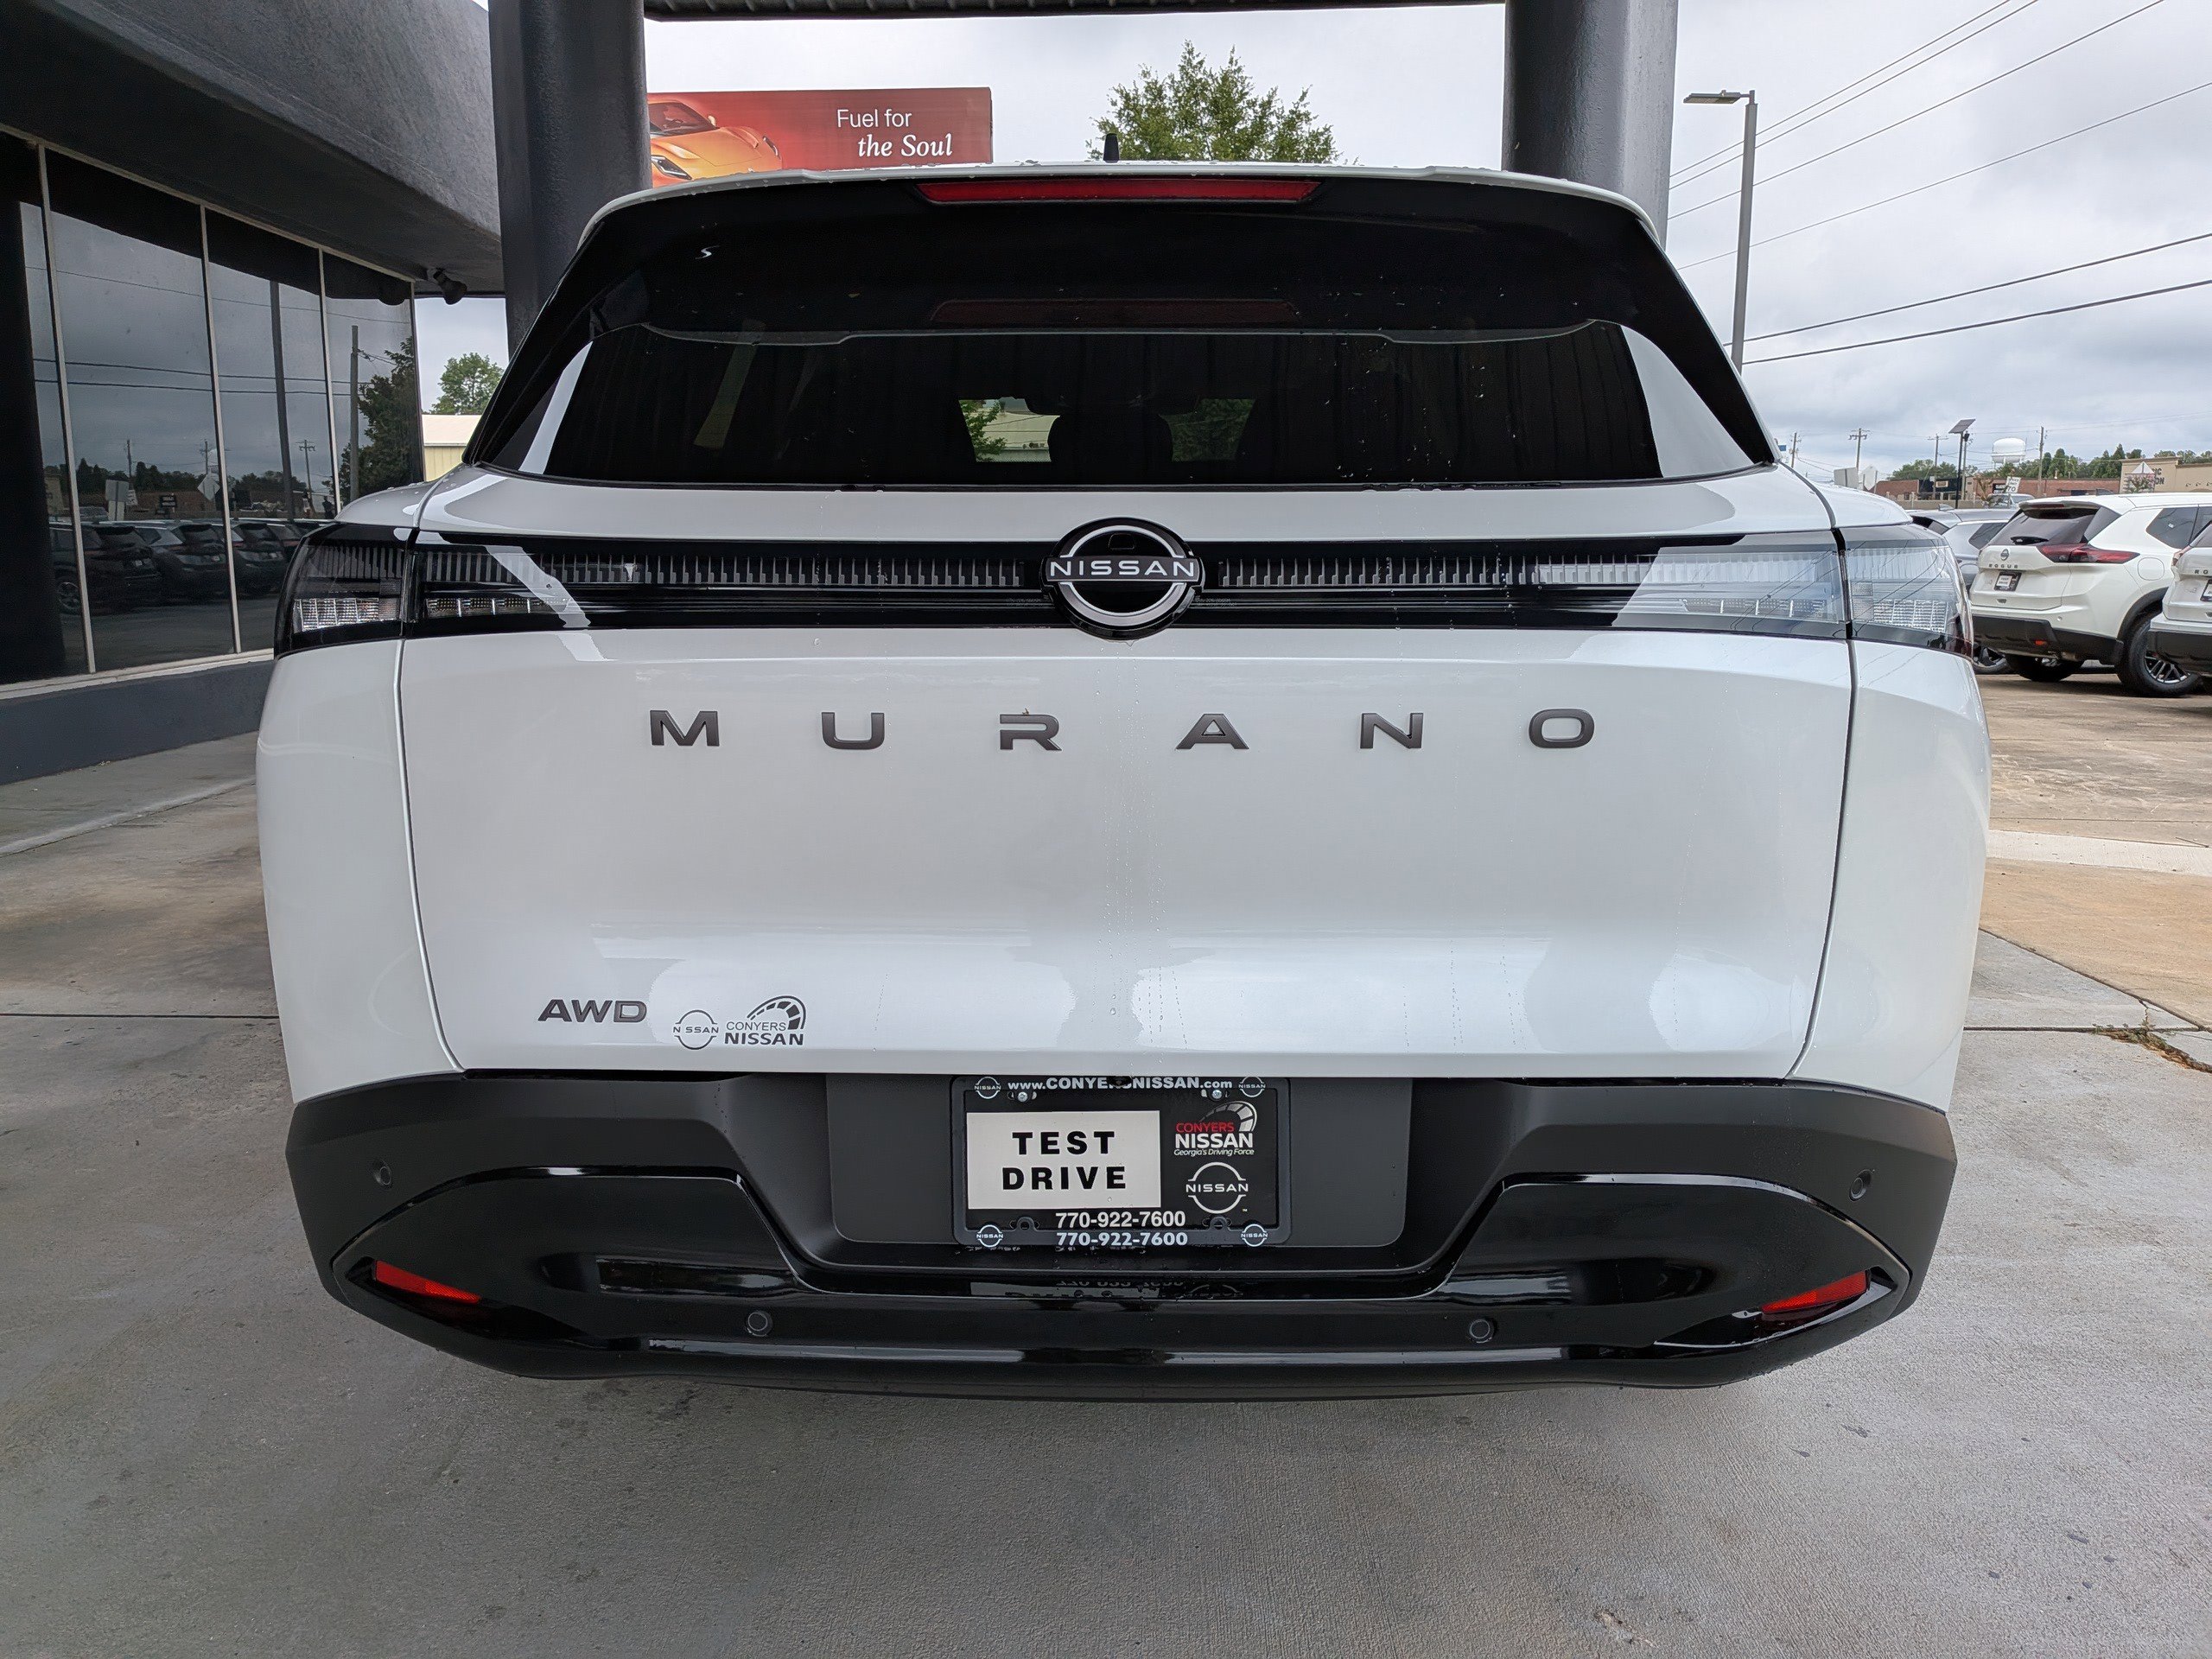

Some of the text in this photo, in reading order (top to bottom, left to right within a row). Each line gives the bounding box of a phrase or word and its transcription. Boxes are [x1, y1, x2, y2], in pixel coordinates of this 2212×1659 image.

[837, 109, 912, 128] Fuel for
[858, 133, 952, 156] the Soul
[1050, 560, 1194, 576] NISSAN
[650, 709, 1596, 751] MURANO
[537, 999, 647, 1023] AWD
[726, 1021, 786, 1031] CONYERS
[724, 1033, 804, 1046] NISSAN
[1007, 1077, 1233, 1090] www.CONYENISSAN.com
[1176, 1122, 1235, 1133] CONYERS
[1012, 1131, 1115, 1154] TEST
[1175, 1133, 1253, 1148] NISSAN
[1174, 1148, 1207, 1157] Georgia's
[1208, 1148, 1233, 1157] Driving
[1002, 1166, 1127, 1190] DRIVE
[1185, 1184, 1249, 1192] NISSAN
[1056, 1211, 1185, 1229] 770-922-7600
[1058, 1232, 1188, 1246] 770-922-7600
